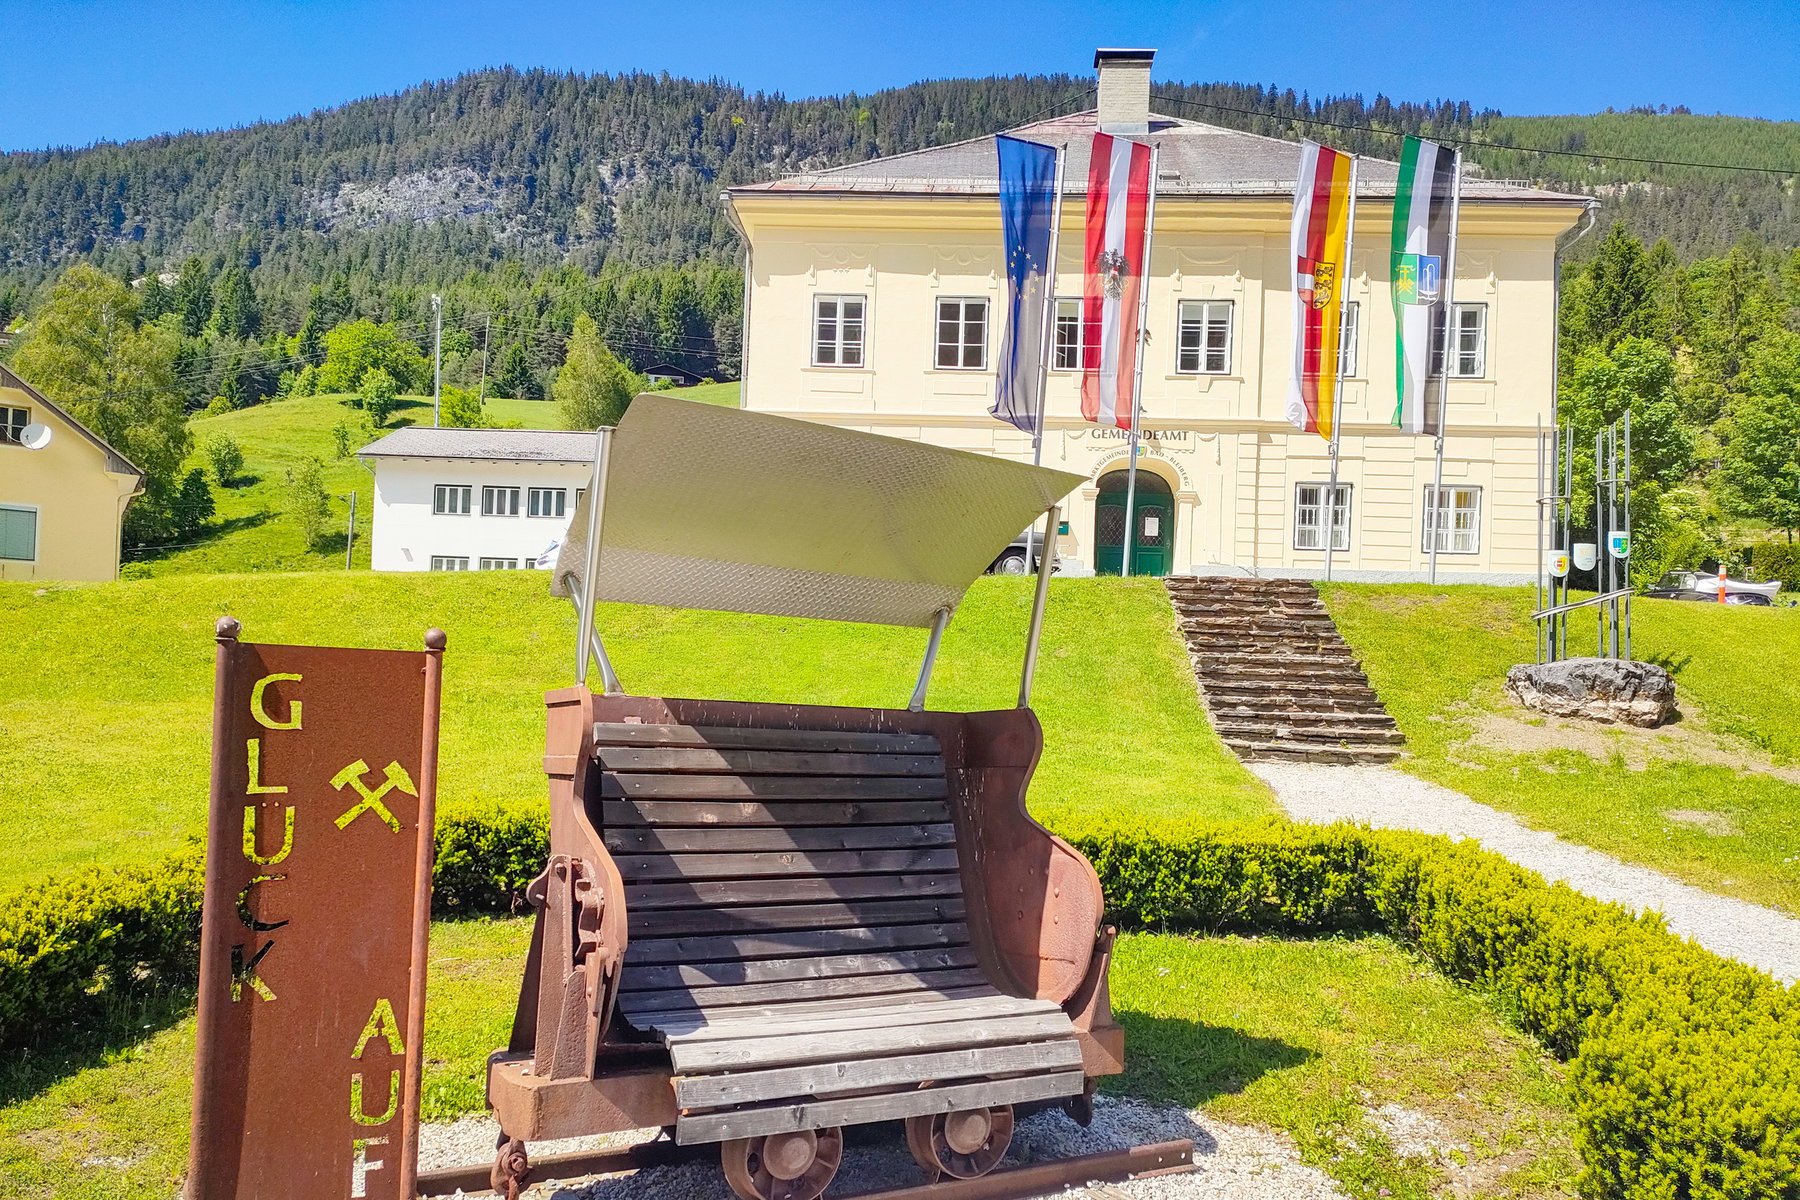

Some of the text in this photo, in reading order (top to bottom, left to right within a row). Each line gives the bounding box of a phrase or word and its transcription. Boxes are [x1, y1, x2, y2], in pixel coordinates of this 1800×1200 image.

[1091, 428, 1189, 441] GEMENDEAMT
[1150, 450, 1164, 458] BAD
[1169, 457, 1190, 487] BLEIBERG
[230, 673, 303, 1002] GLÜCK
[350, 998, 405, 1198] AUF
